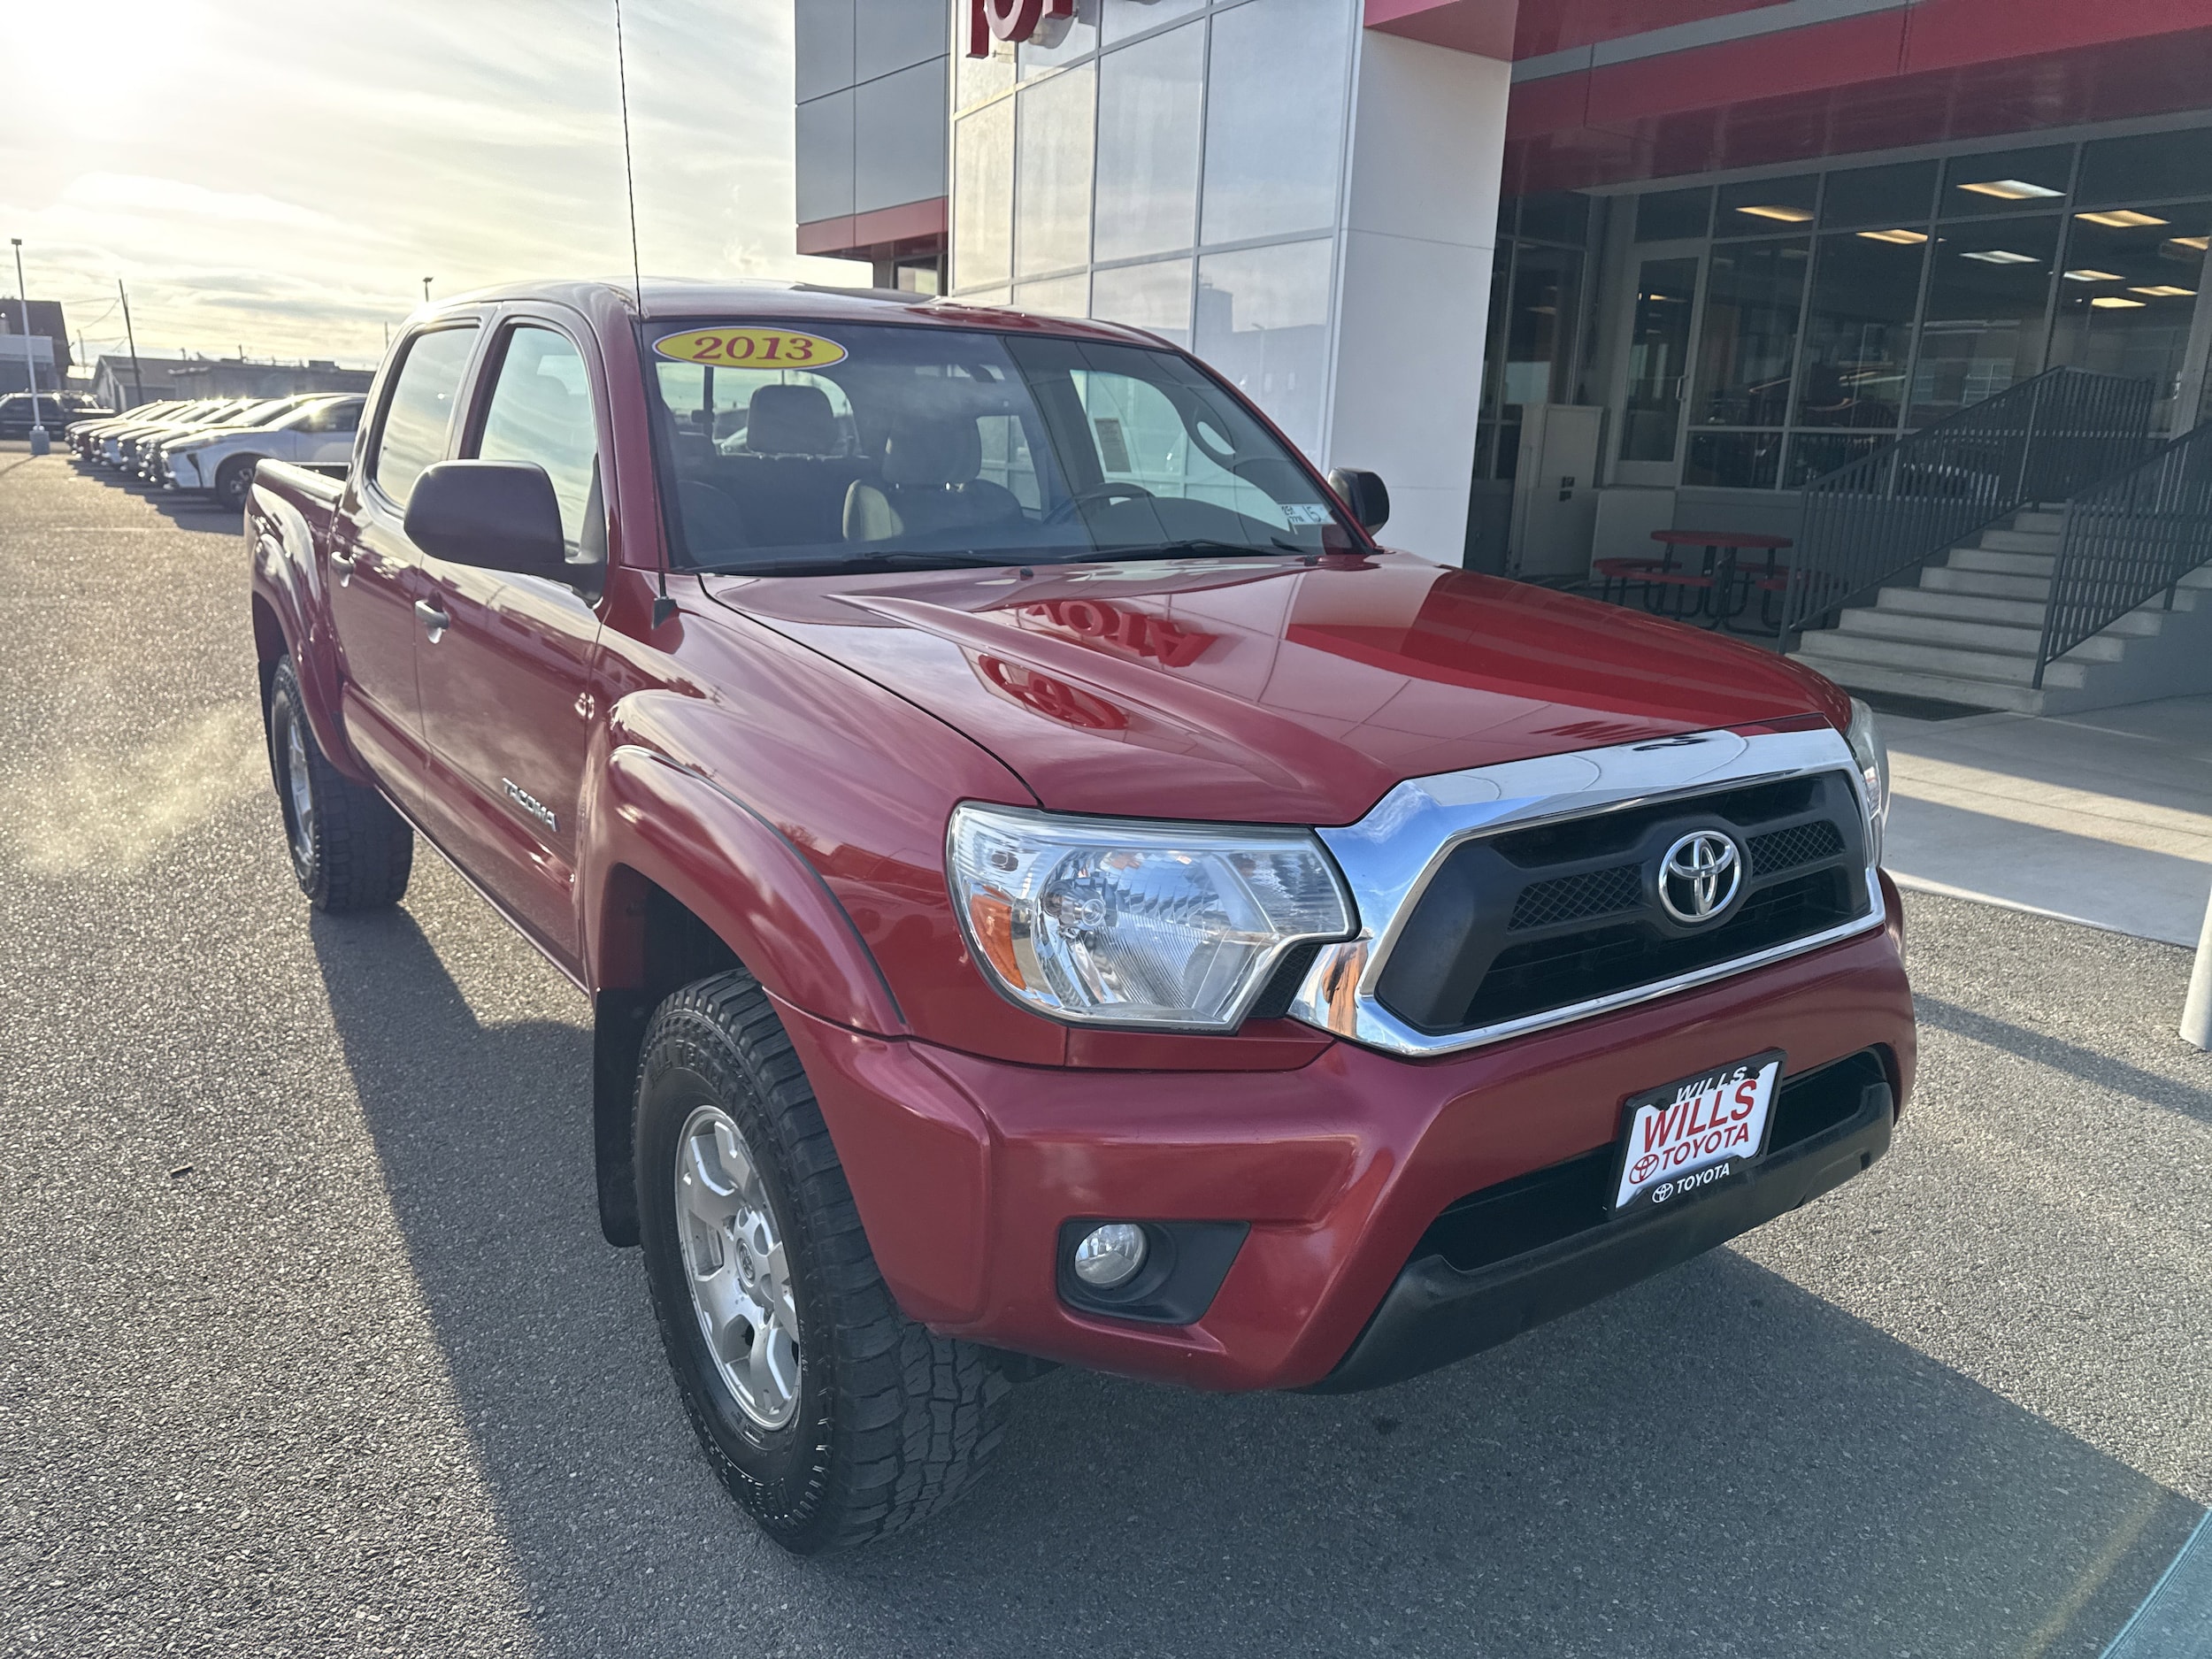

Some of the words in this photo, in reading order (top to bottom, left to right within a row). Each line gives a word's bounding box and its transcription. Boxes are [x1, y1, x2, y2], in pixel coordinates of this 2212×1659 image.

[692, 336, 813, 360] 2013
[502, 777, 557, 833] TACOMA
[1675, 1065, 1747, 1103] WILLS
[1644, 1078, 1757, 1153] WILLS
[1662, 1122, 1749, 1171] TOYOTA
[1676, 1162, 1730, 1194] TOYOTA
